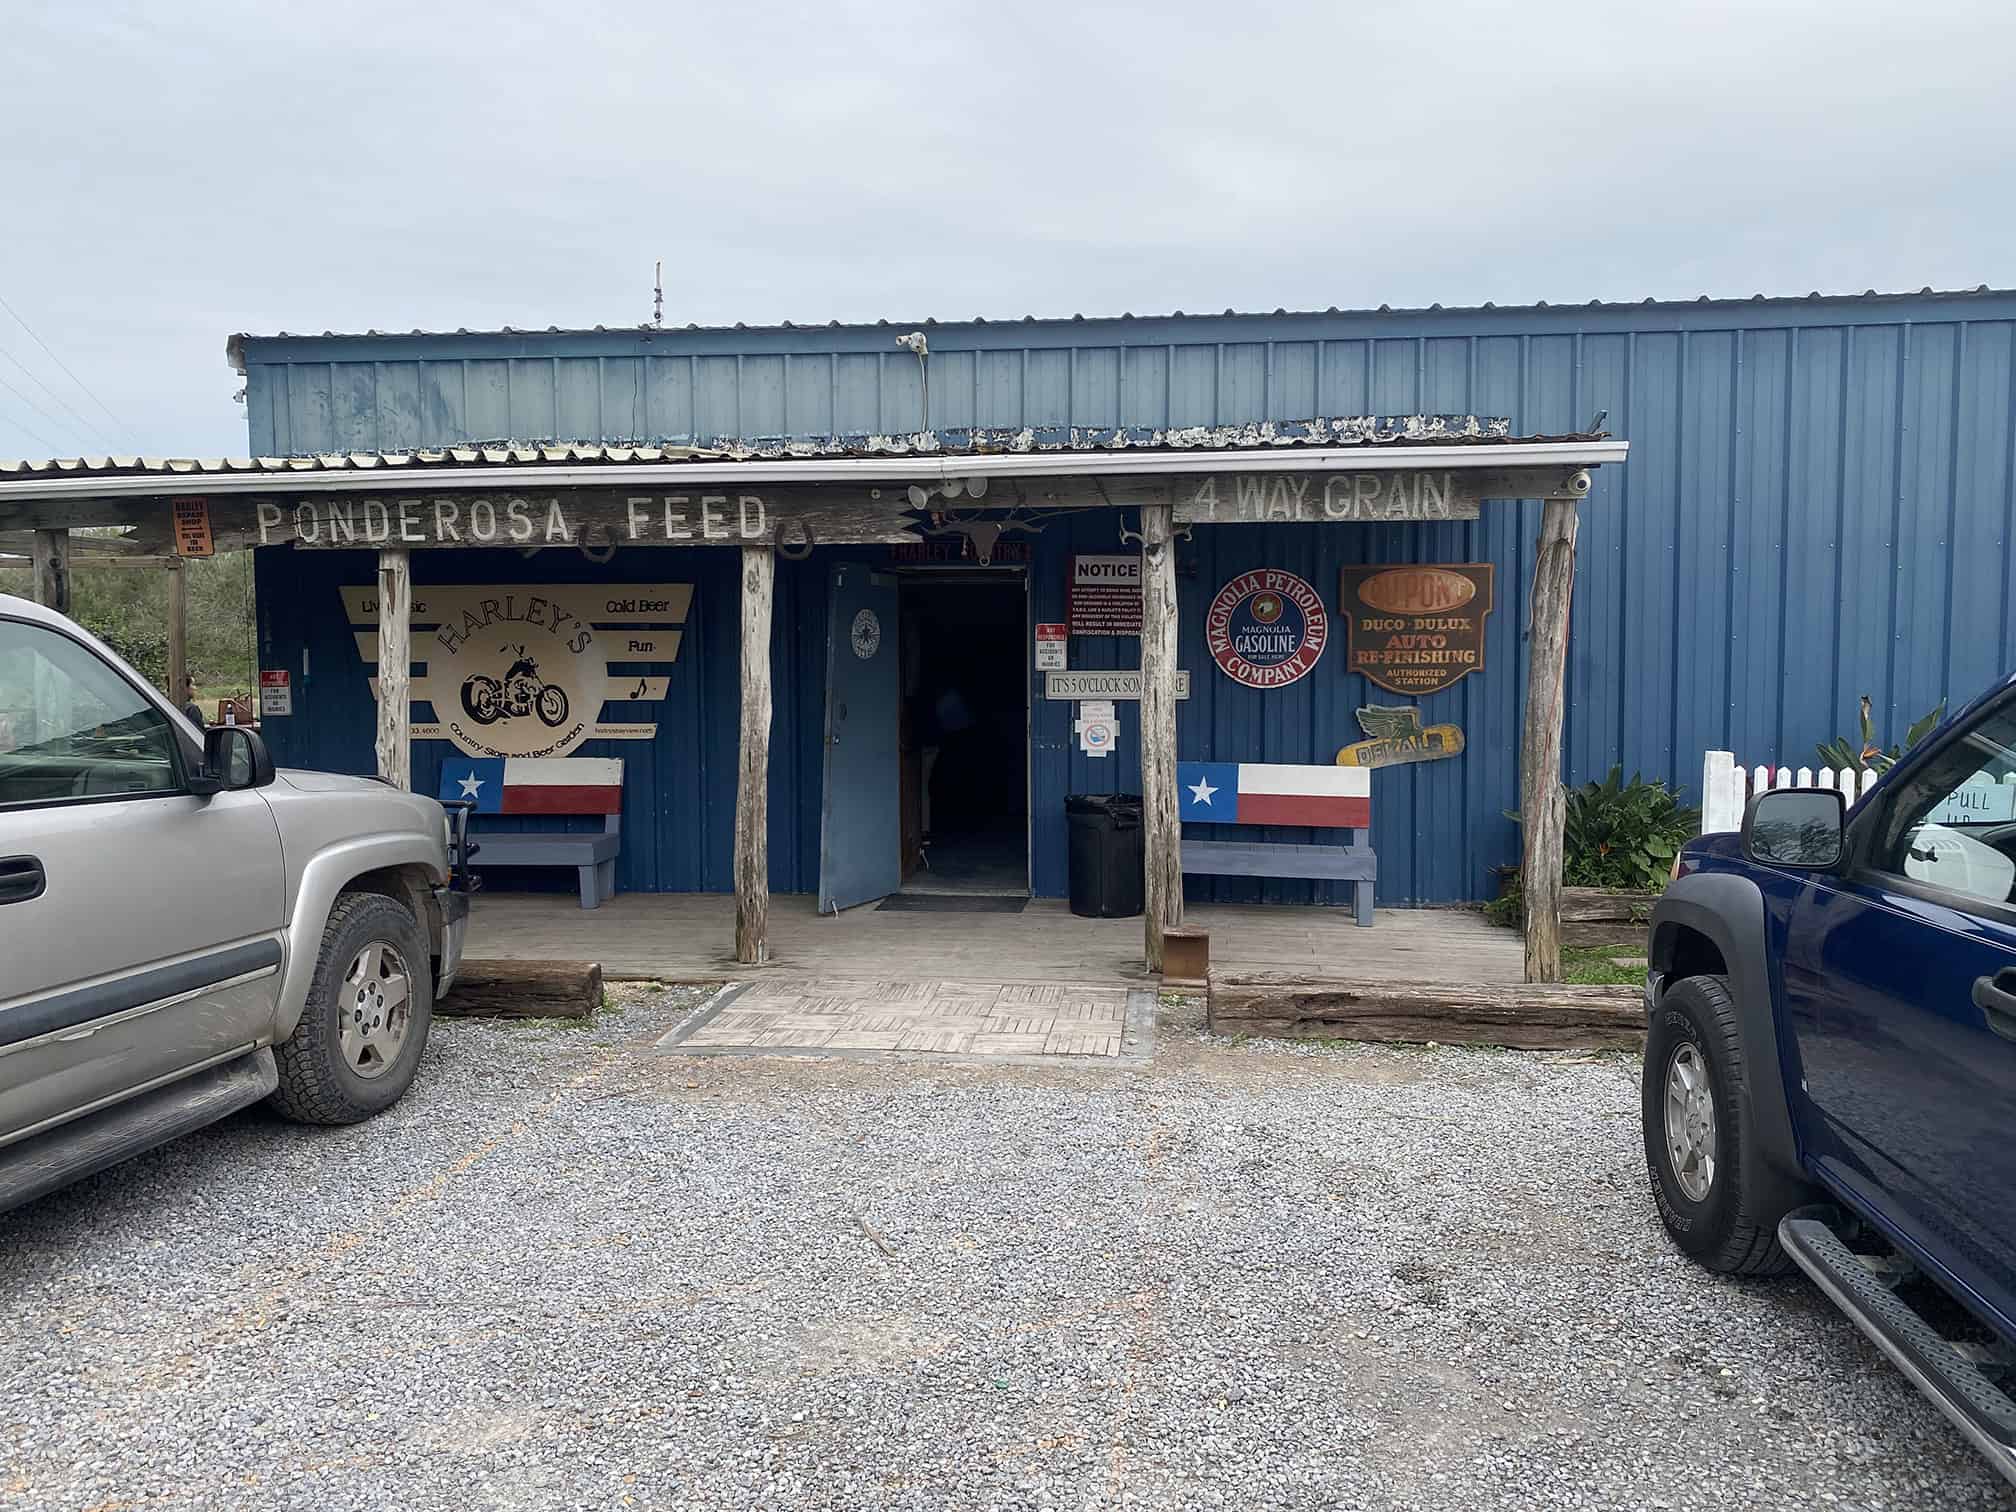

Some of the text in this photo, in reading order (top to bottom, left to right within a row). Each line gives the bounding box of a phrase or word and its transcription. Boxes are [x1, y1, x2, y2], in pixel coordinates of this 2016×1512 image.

[1194, 472, 1452, 521] 4 WAY GRAIN
[256, 495, 769, 546] PONDEROSA FEED
[1078, 563, 1138, 577] NOTICE
[361, 600, 380, 613] Liv
[606, 599, 670, 613] Cold Beer
[1211, 572, 1325, 654] MAGNOLIA PETROLEUM
[437, 595, 593, 655] HARLEY'S
[1241, 625, 1291, 634] MAGNOLIA
[1360, 618, 1473, 631] DUCO DULUX
[627, 639, 653, 653] Fun
[1235, 635, 1297, 653] GASOLINE
[1386, 634, 1447, 649] AUTO
[1357, 650, 1476, 665] RE-FINISHING
[1227, 654, 1307, 684] COMPANY
[1386, 669, 1448, 678] AUTHORIZED
[1052, 678, 1070, 693] IT'S
[1071, 678, 1077, 693] 5
[1078, 678, 1122, 693] O'CLOCK
[1395, 677, 1439, 686] STATION
[450, 721, 484, 751] Country
[532, 744, 555, 758] Beer
[556, 722, 585, 750] Garden
[1947, 791, 1991, 810] PULL
